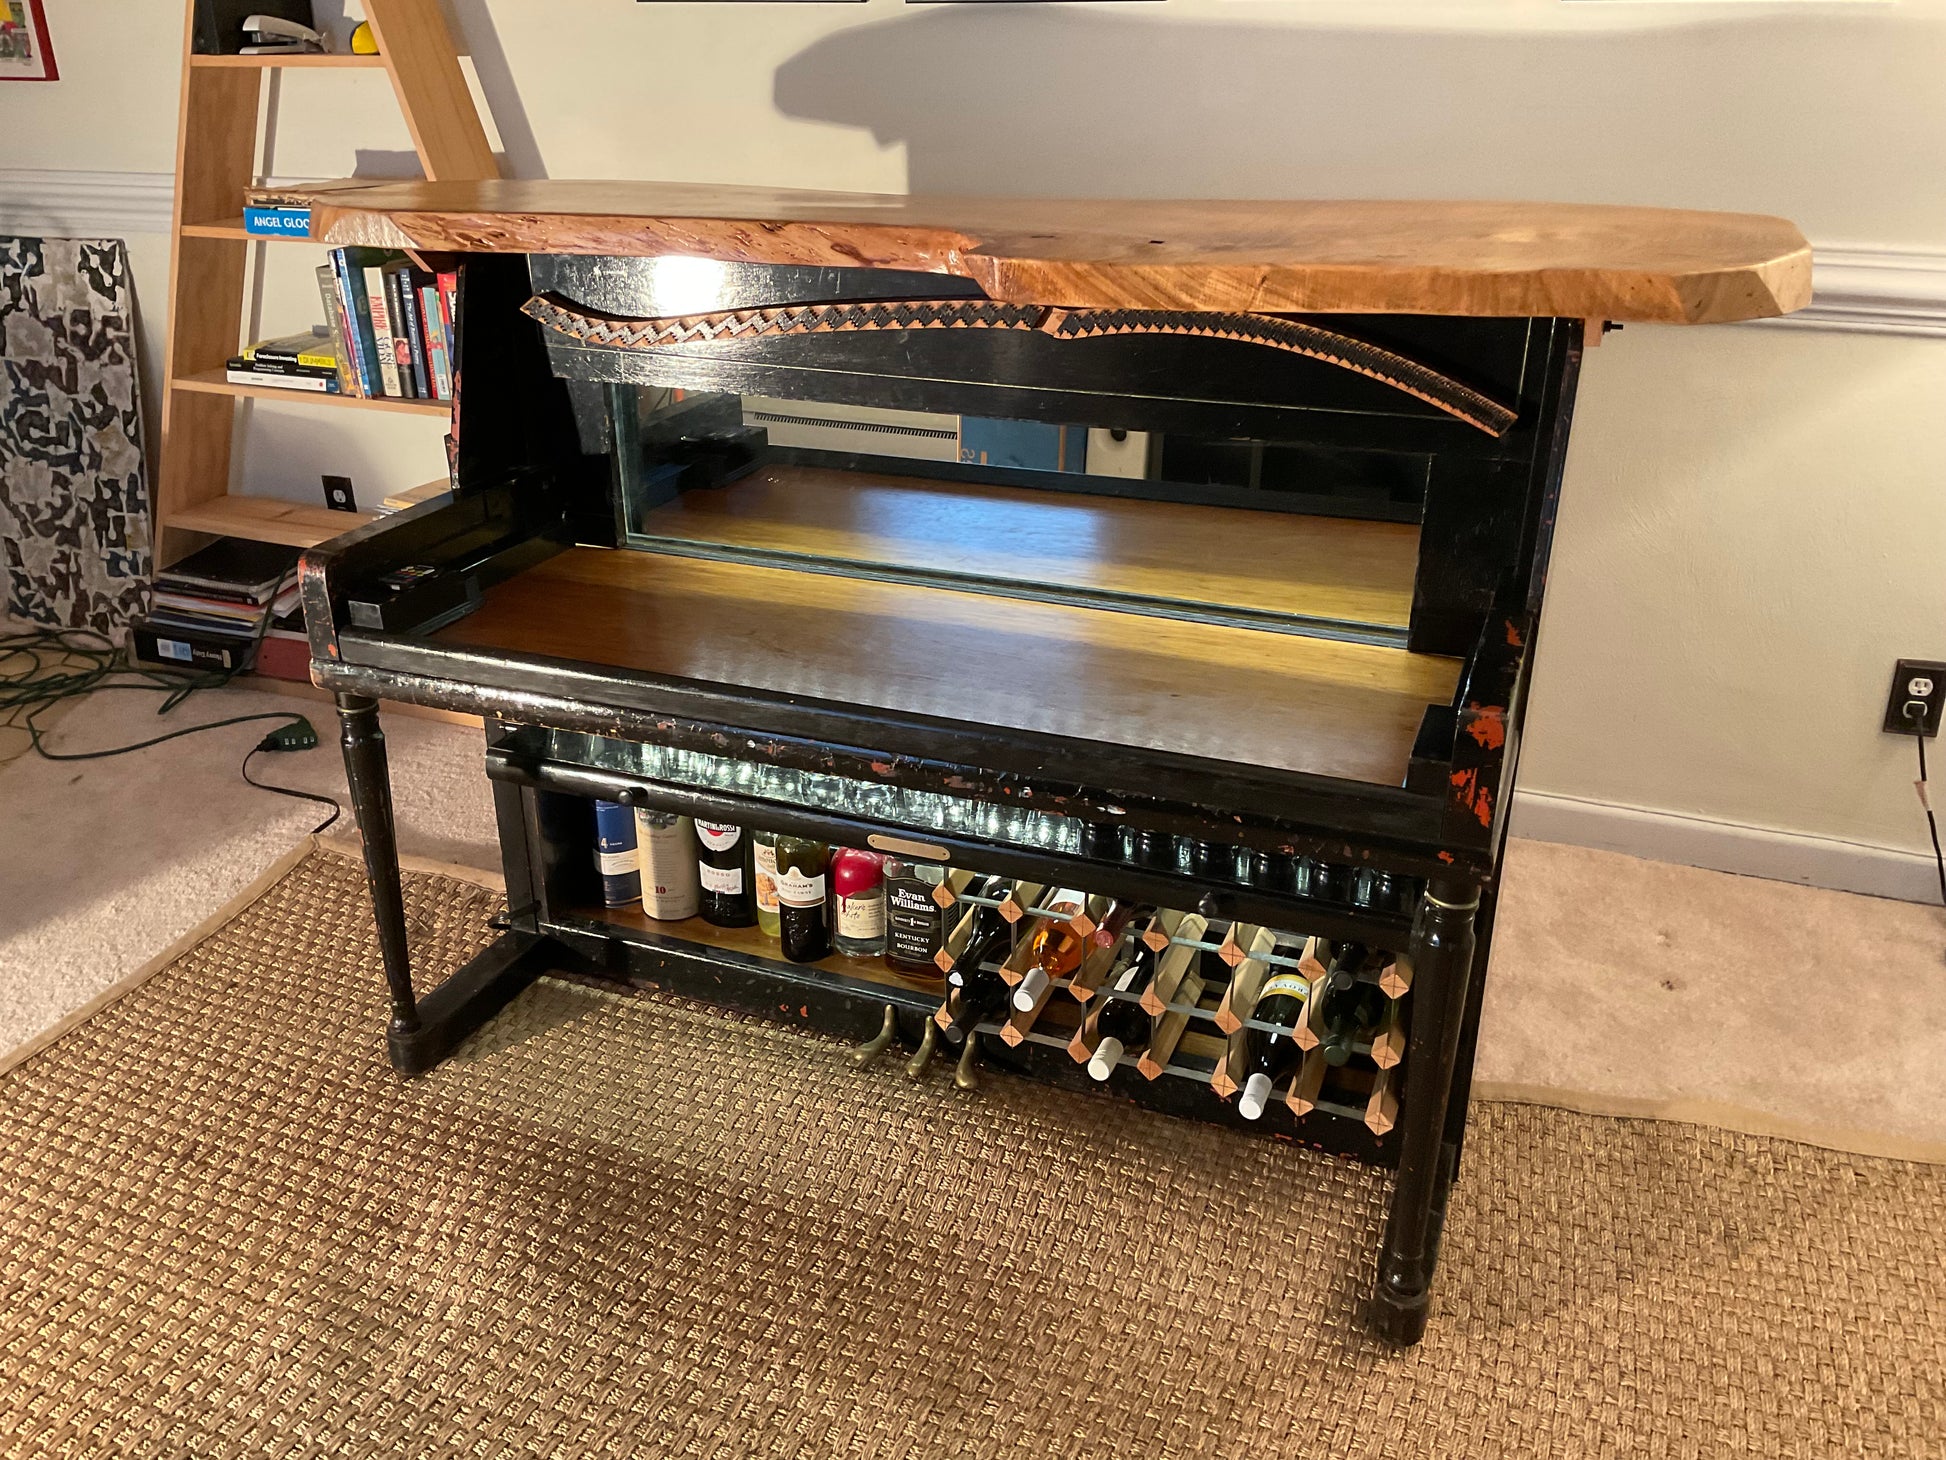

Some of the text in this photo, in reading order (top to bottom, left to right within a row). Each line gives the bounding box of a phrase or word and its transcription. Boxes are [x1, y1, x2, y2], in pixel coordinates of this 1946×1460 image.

[254, 216, 282, 227] ANGEL
[324, 293, 335, 327] Database
[370, 296, 389, 330] EMPIRE
[279, 355, 297, 363] Investing
[601, 838, 608, 849] 4
[780, 880, 813, 888] GRAHAM'S
[655, 886, 666, 894] 10
[898, 888, 925, 902] Evan
[890, 895, 935, 912] Williams
[894, 932, 930, 943] KENTUCKY
[896, 943, 928, 953] BOURBON
